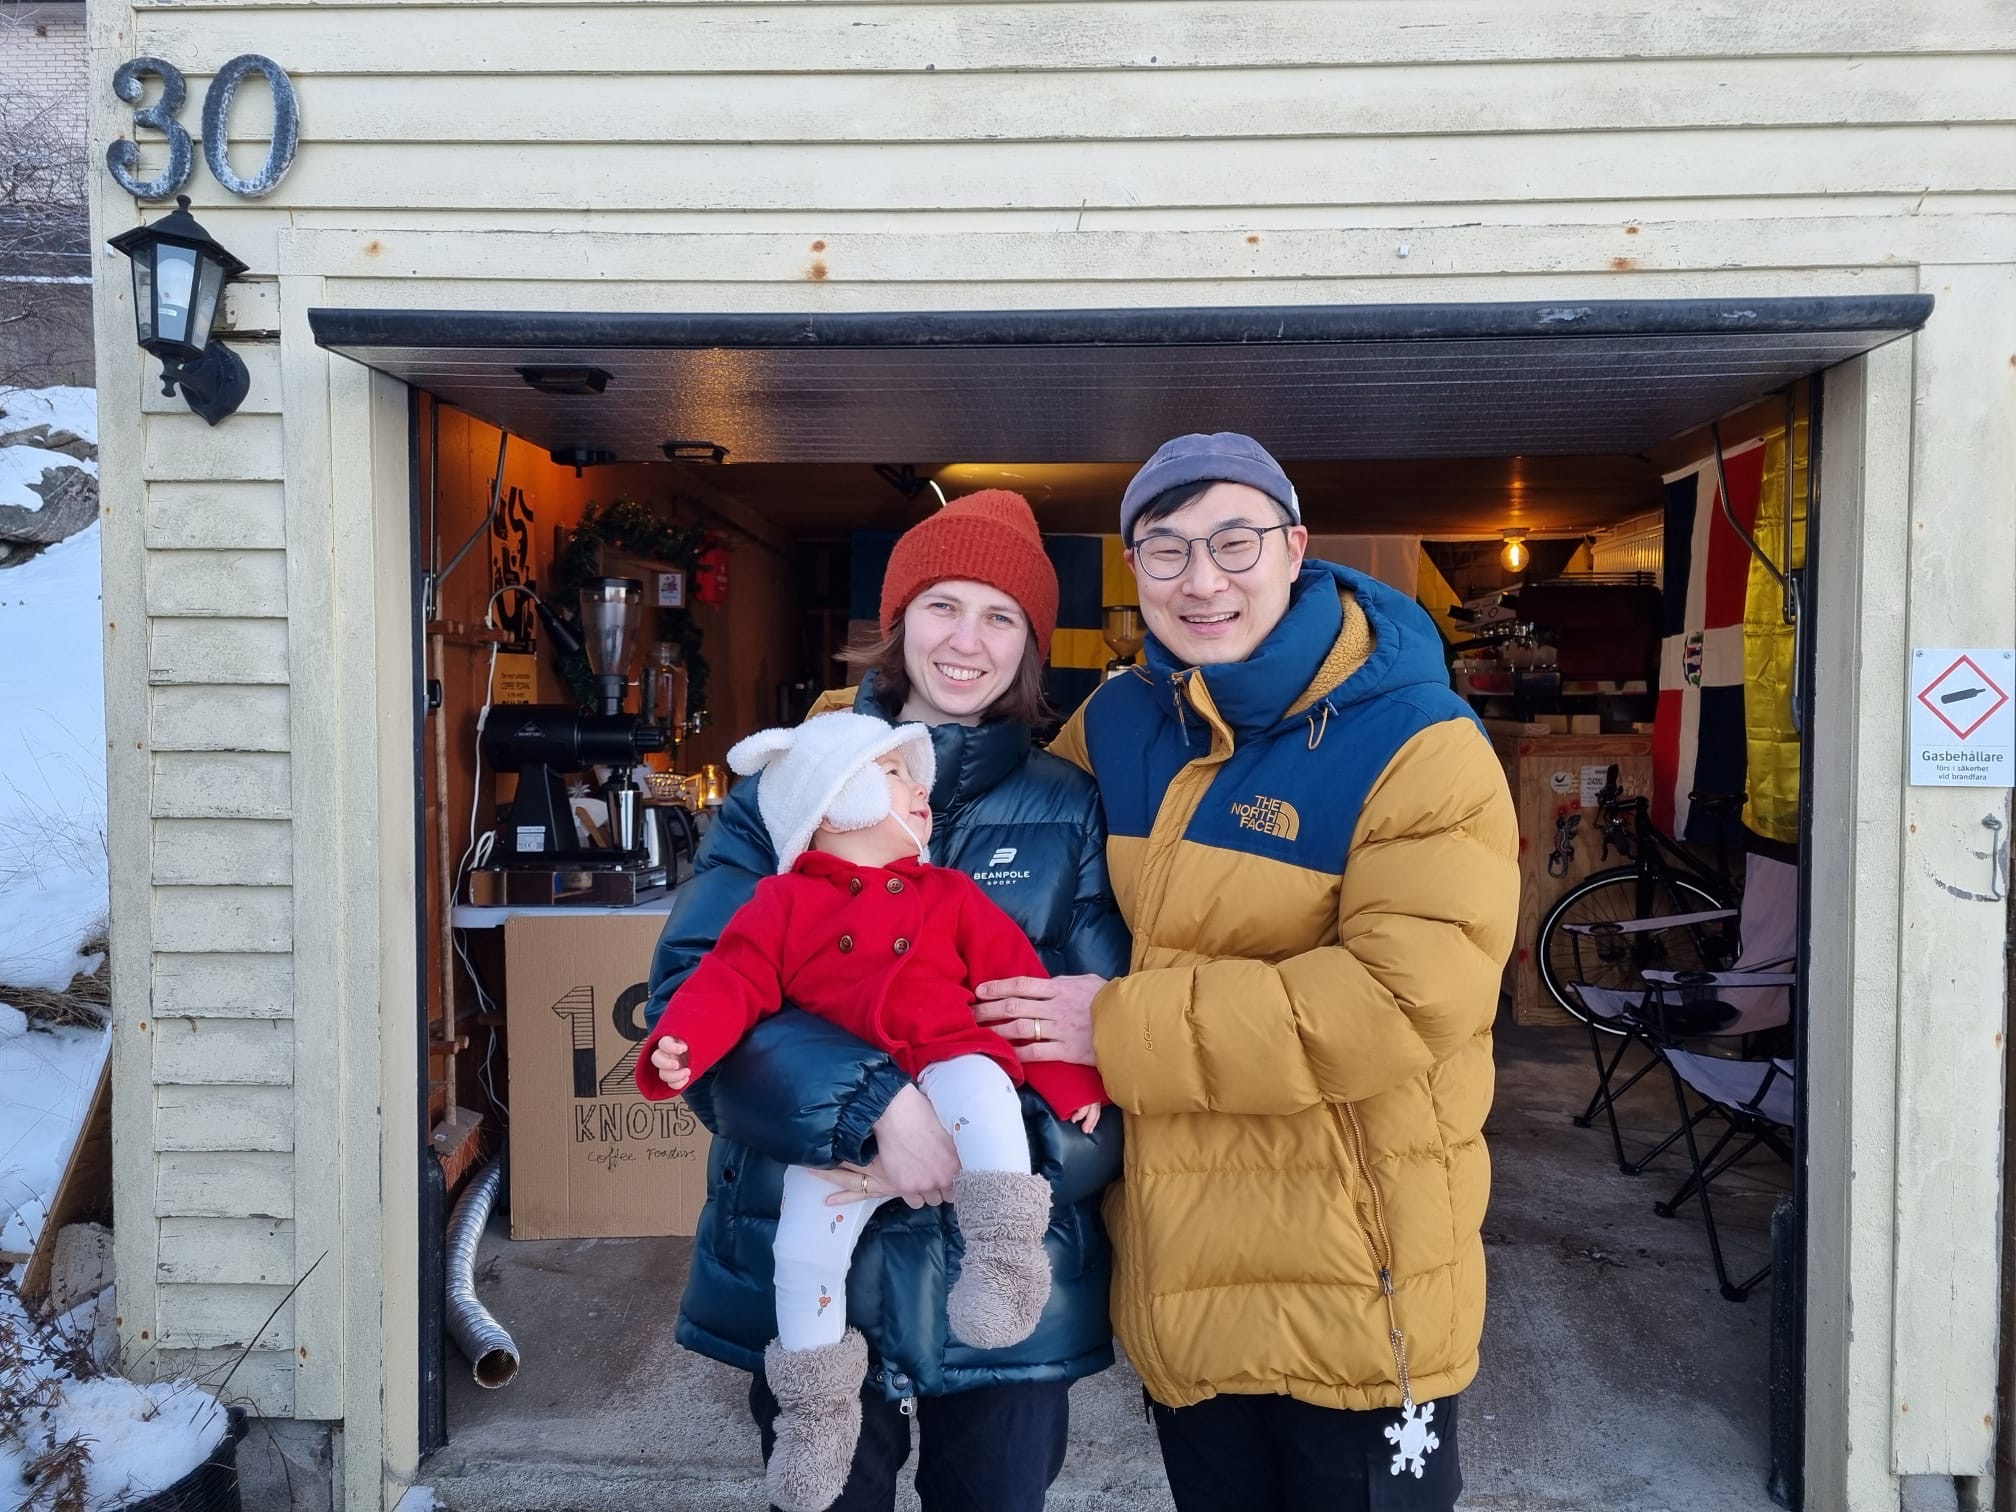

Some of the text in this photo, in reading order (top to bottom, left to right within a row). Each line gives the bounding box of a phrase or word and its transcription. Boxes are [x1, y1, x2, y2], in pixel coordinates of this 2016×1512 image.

[106, 53, 300, 199] 30
[1922, 750, 2004, 763] Gasbehållare
[1936, 764, 1951, 772] förs
[1957, 764, 1989, 773] säkerhet
[1952, 773, 1987, 781] brandfara
[1255, 795, 1281, 812] THE
[1231, 803, 1278, 824] NORTH
[1240, 816, 1275, 834] FACE
[973, 871, 1031, 880] BEANPOLE
[574, 1102, 697, 1142] KNOTS
